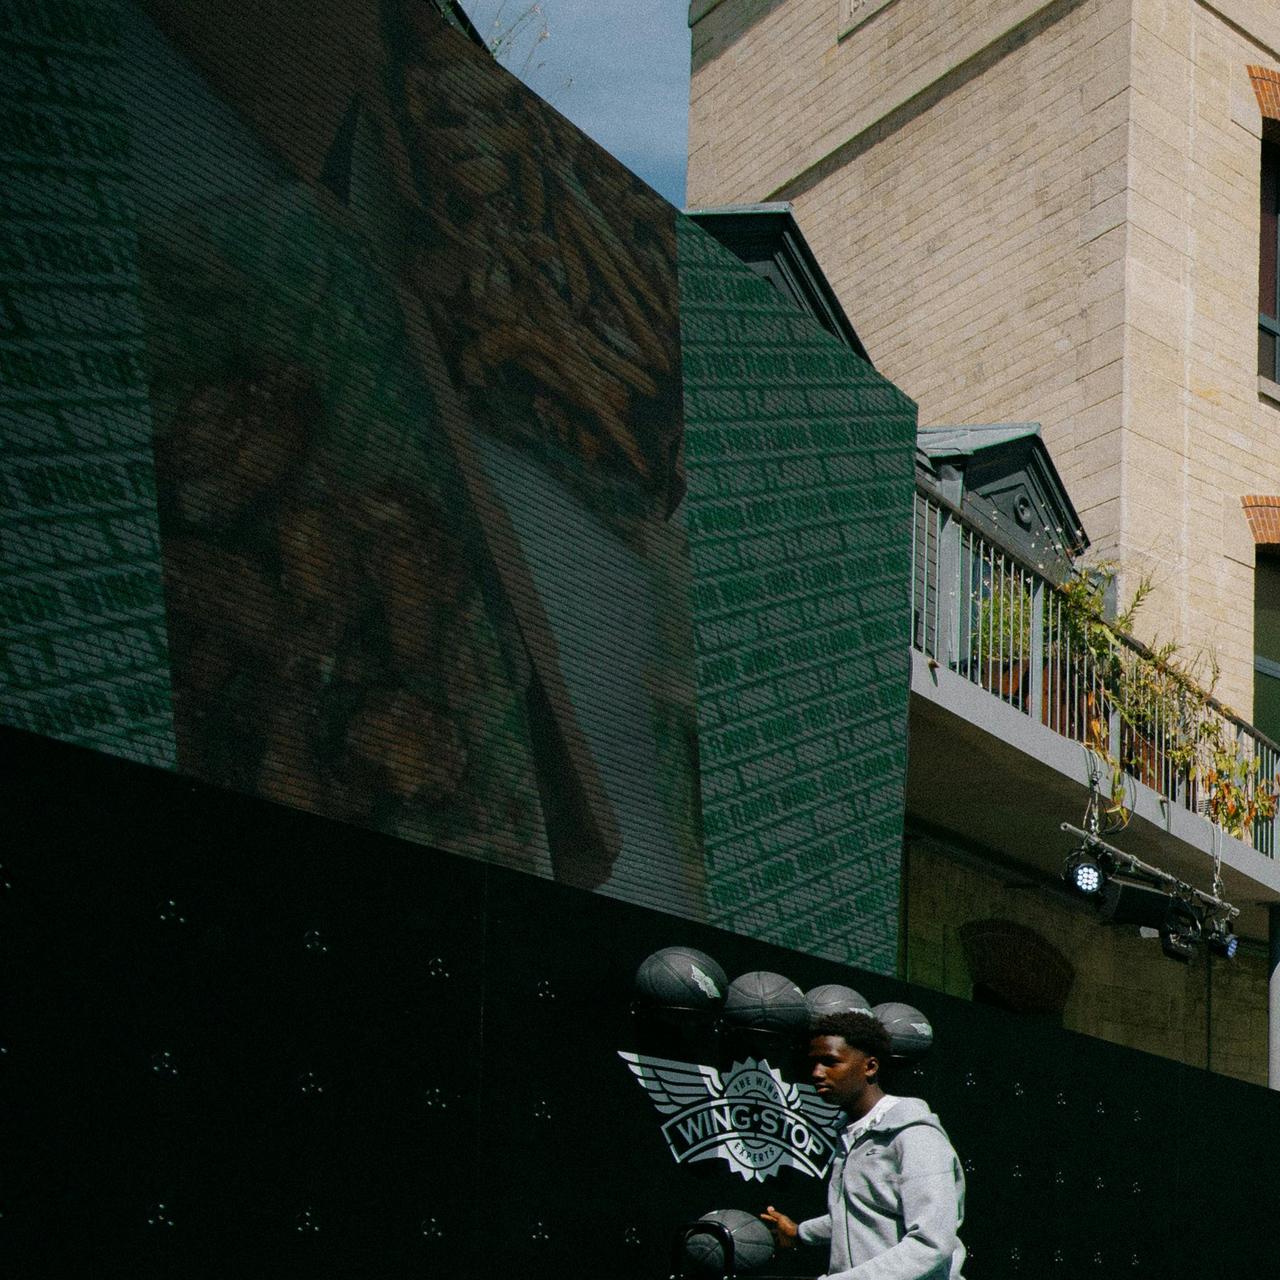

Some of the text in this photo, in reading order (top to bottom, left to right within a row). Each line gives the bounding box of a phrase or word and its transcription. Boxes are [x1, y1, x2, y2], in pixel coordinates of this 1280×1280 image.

[733, 1075, 780, 1100] THE WING
[734, 1142, 775, 1163] EXPERTS
